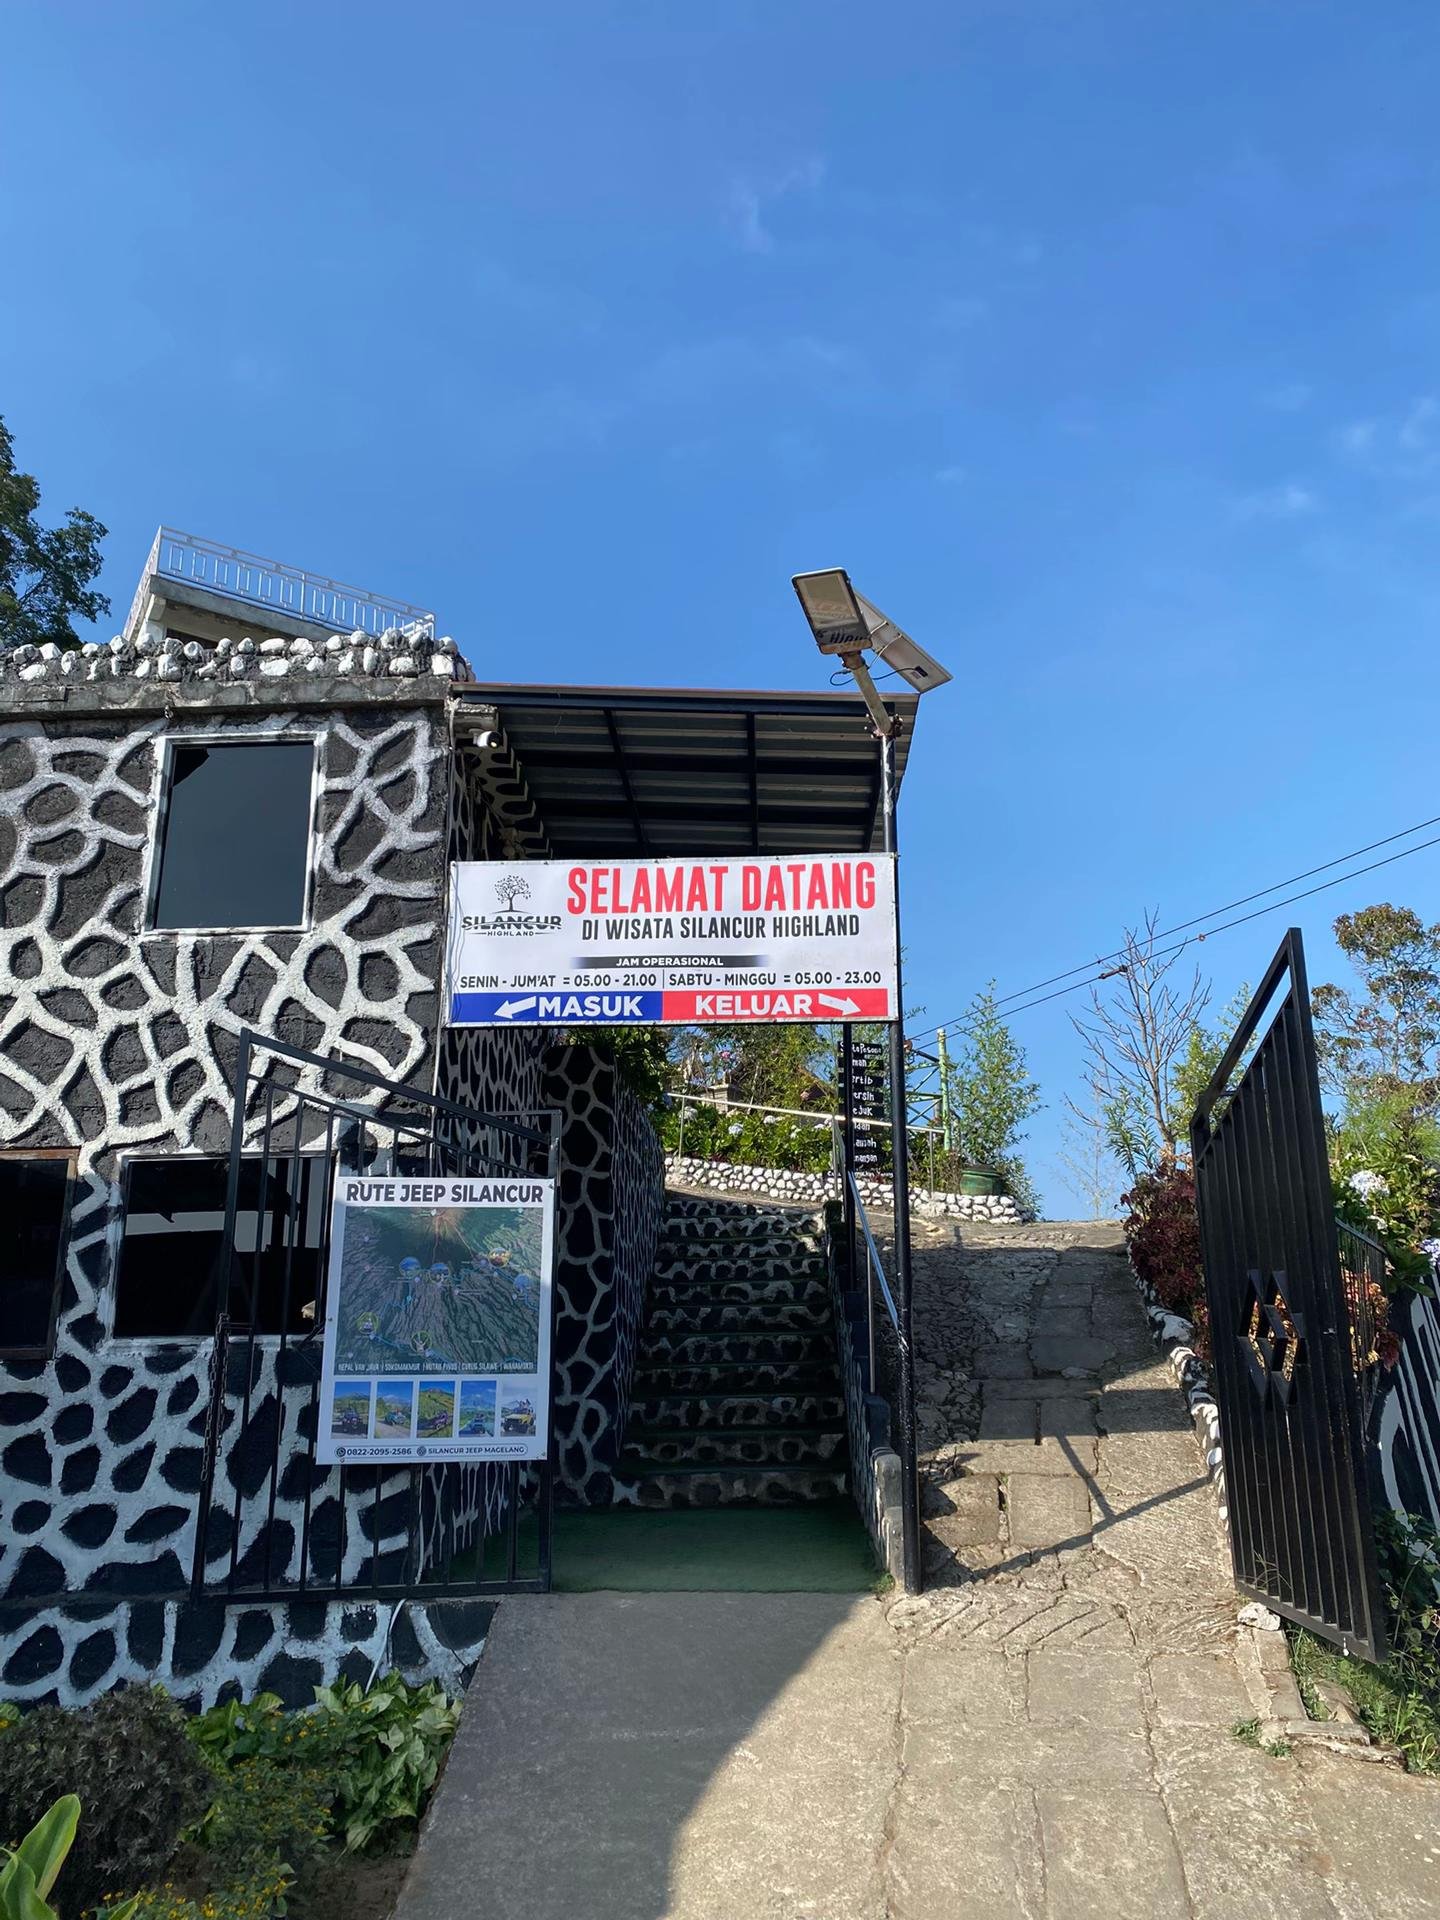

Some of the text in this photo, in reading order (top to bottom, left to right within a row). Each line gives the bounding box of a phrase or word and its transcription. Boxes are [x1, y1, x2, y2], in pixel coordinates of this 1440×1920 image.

[567, 861, 876, 915] SELAMAT DATANG
[461, 915, 562, 930] SILANCUR
[582, 914, 860, 940] DI WISATA SILANCUR HIGHLAND
[616, 956, 724, 967] JAM OPERASIONAL
[460, 976, 499, 988] SENIN
[510, 974, 556, 988] JUM'AT
[574, 974, 611, 987] 05.00
[623, 973, 657, 986] 21.00
[669, 973, 712, 986] SABTU
[724, 973, 777, 986] MINGGU
[794, 972, 832, 985] 05.00
[844, 971, 881, 984] 23.00
[538, 995, 643, 1018] MASUK
[695, 994, 813, 1016] KELUAR
[347, 1183, 543, 1202] RUTE JEEP SILANCUR
[346, 1448, 412, 1456] 0822-2095-2586
[428, 1447, 464, 1455] SILANCUR
[484, 1446, 525, 1454] MAGELANG
